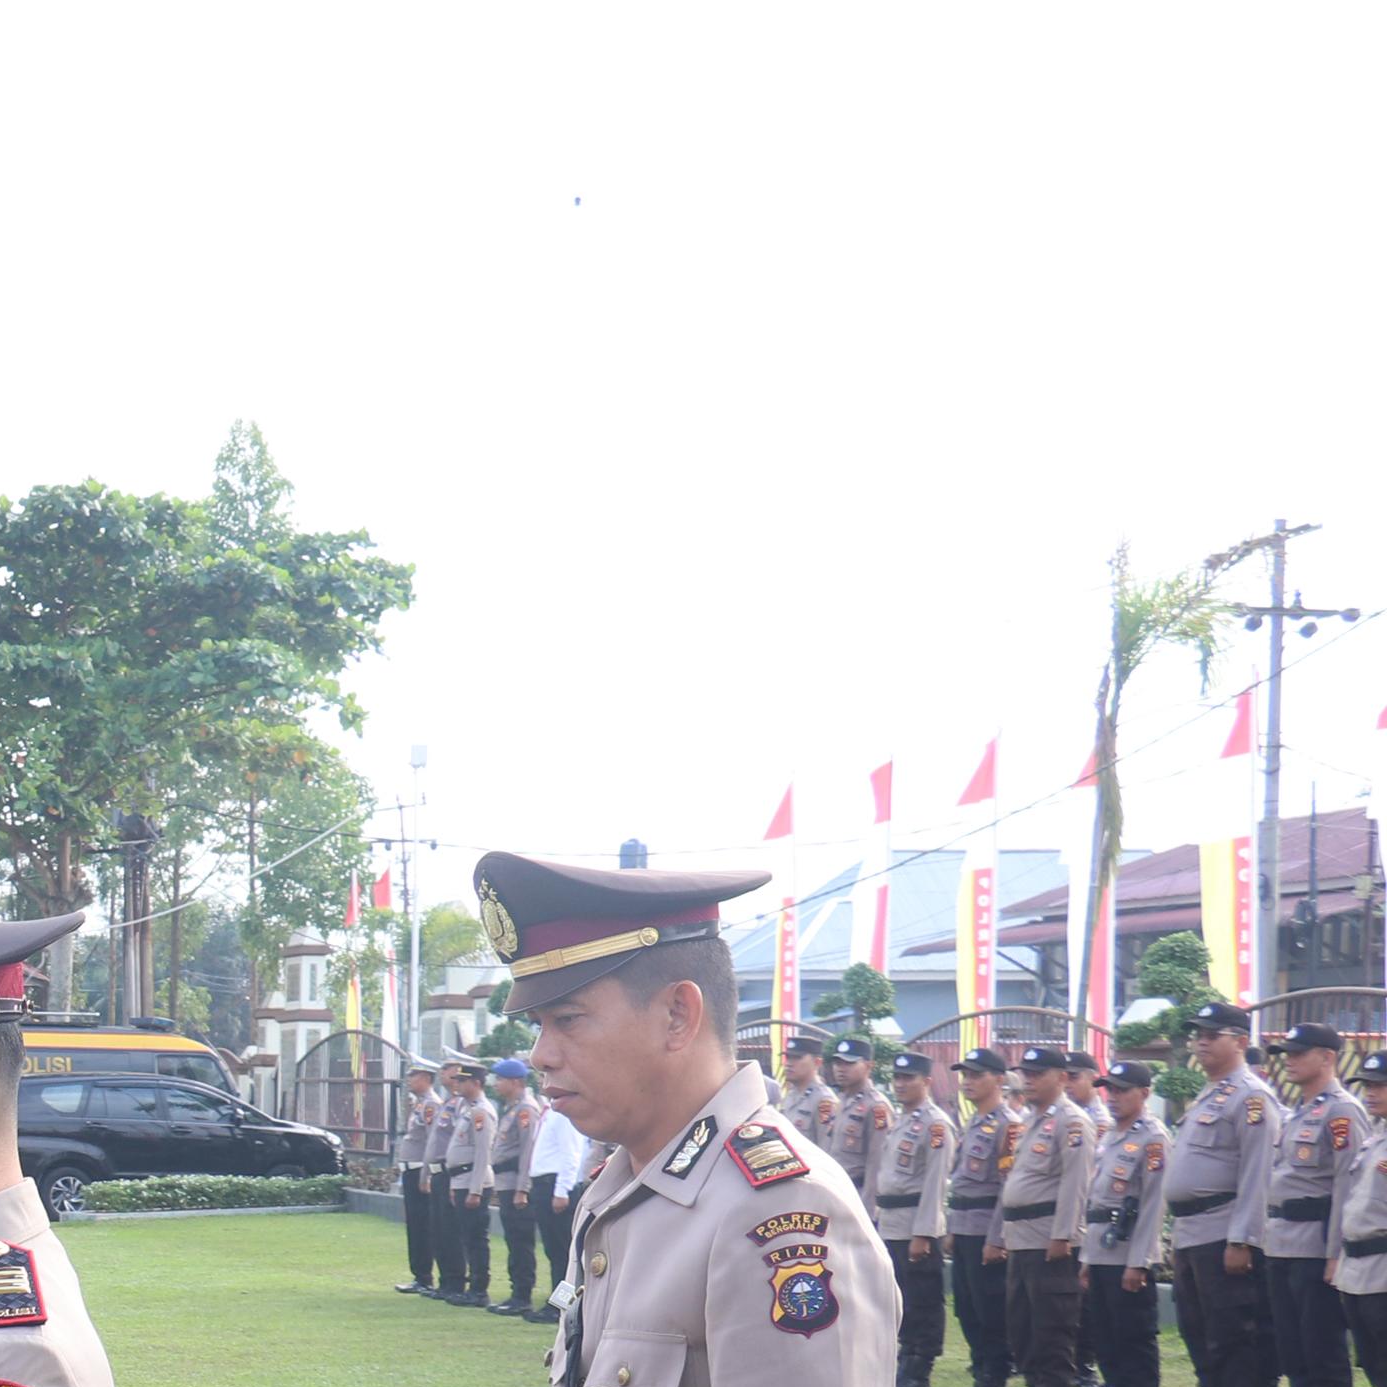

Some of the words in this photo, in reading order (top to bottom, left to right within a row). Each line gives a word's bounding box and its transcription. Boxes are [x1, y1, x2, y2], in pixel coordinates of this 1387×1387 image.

[755, 1214, 821, 1236] POLRES
[764, 1221, 815, 1239] BENGKALIS
[769, 1246, 821, 1263] RIAU
